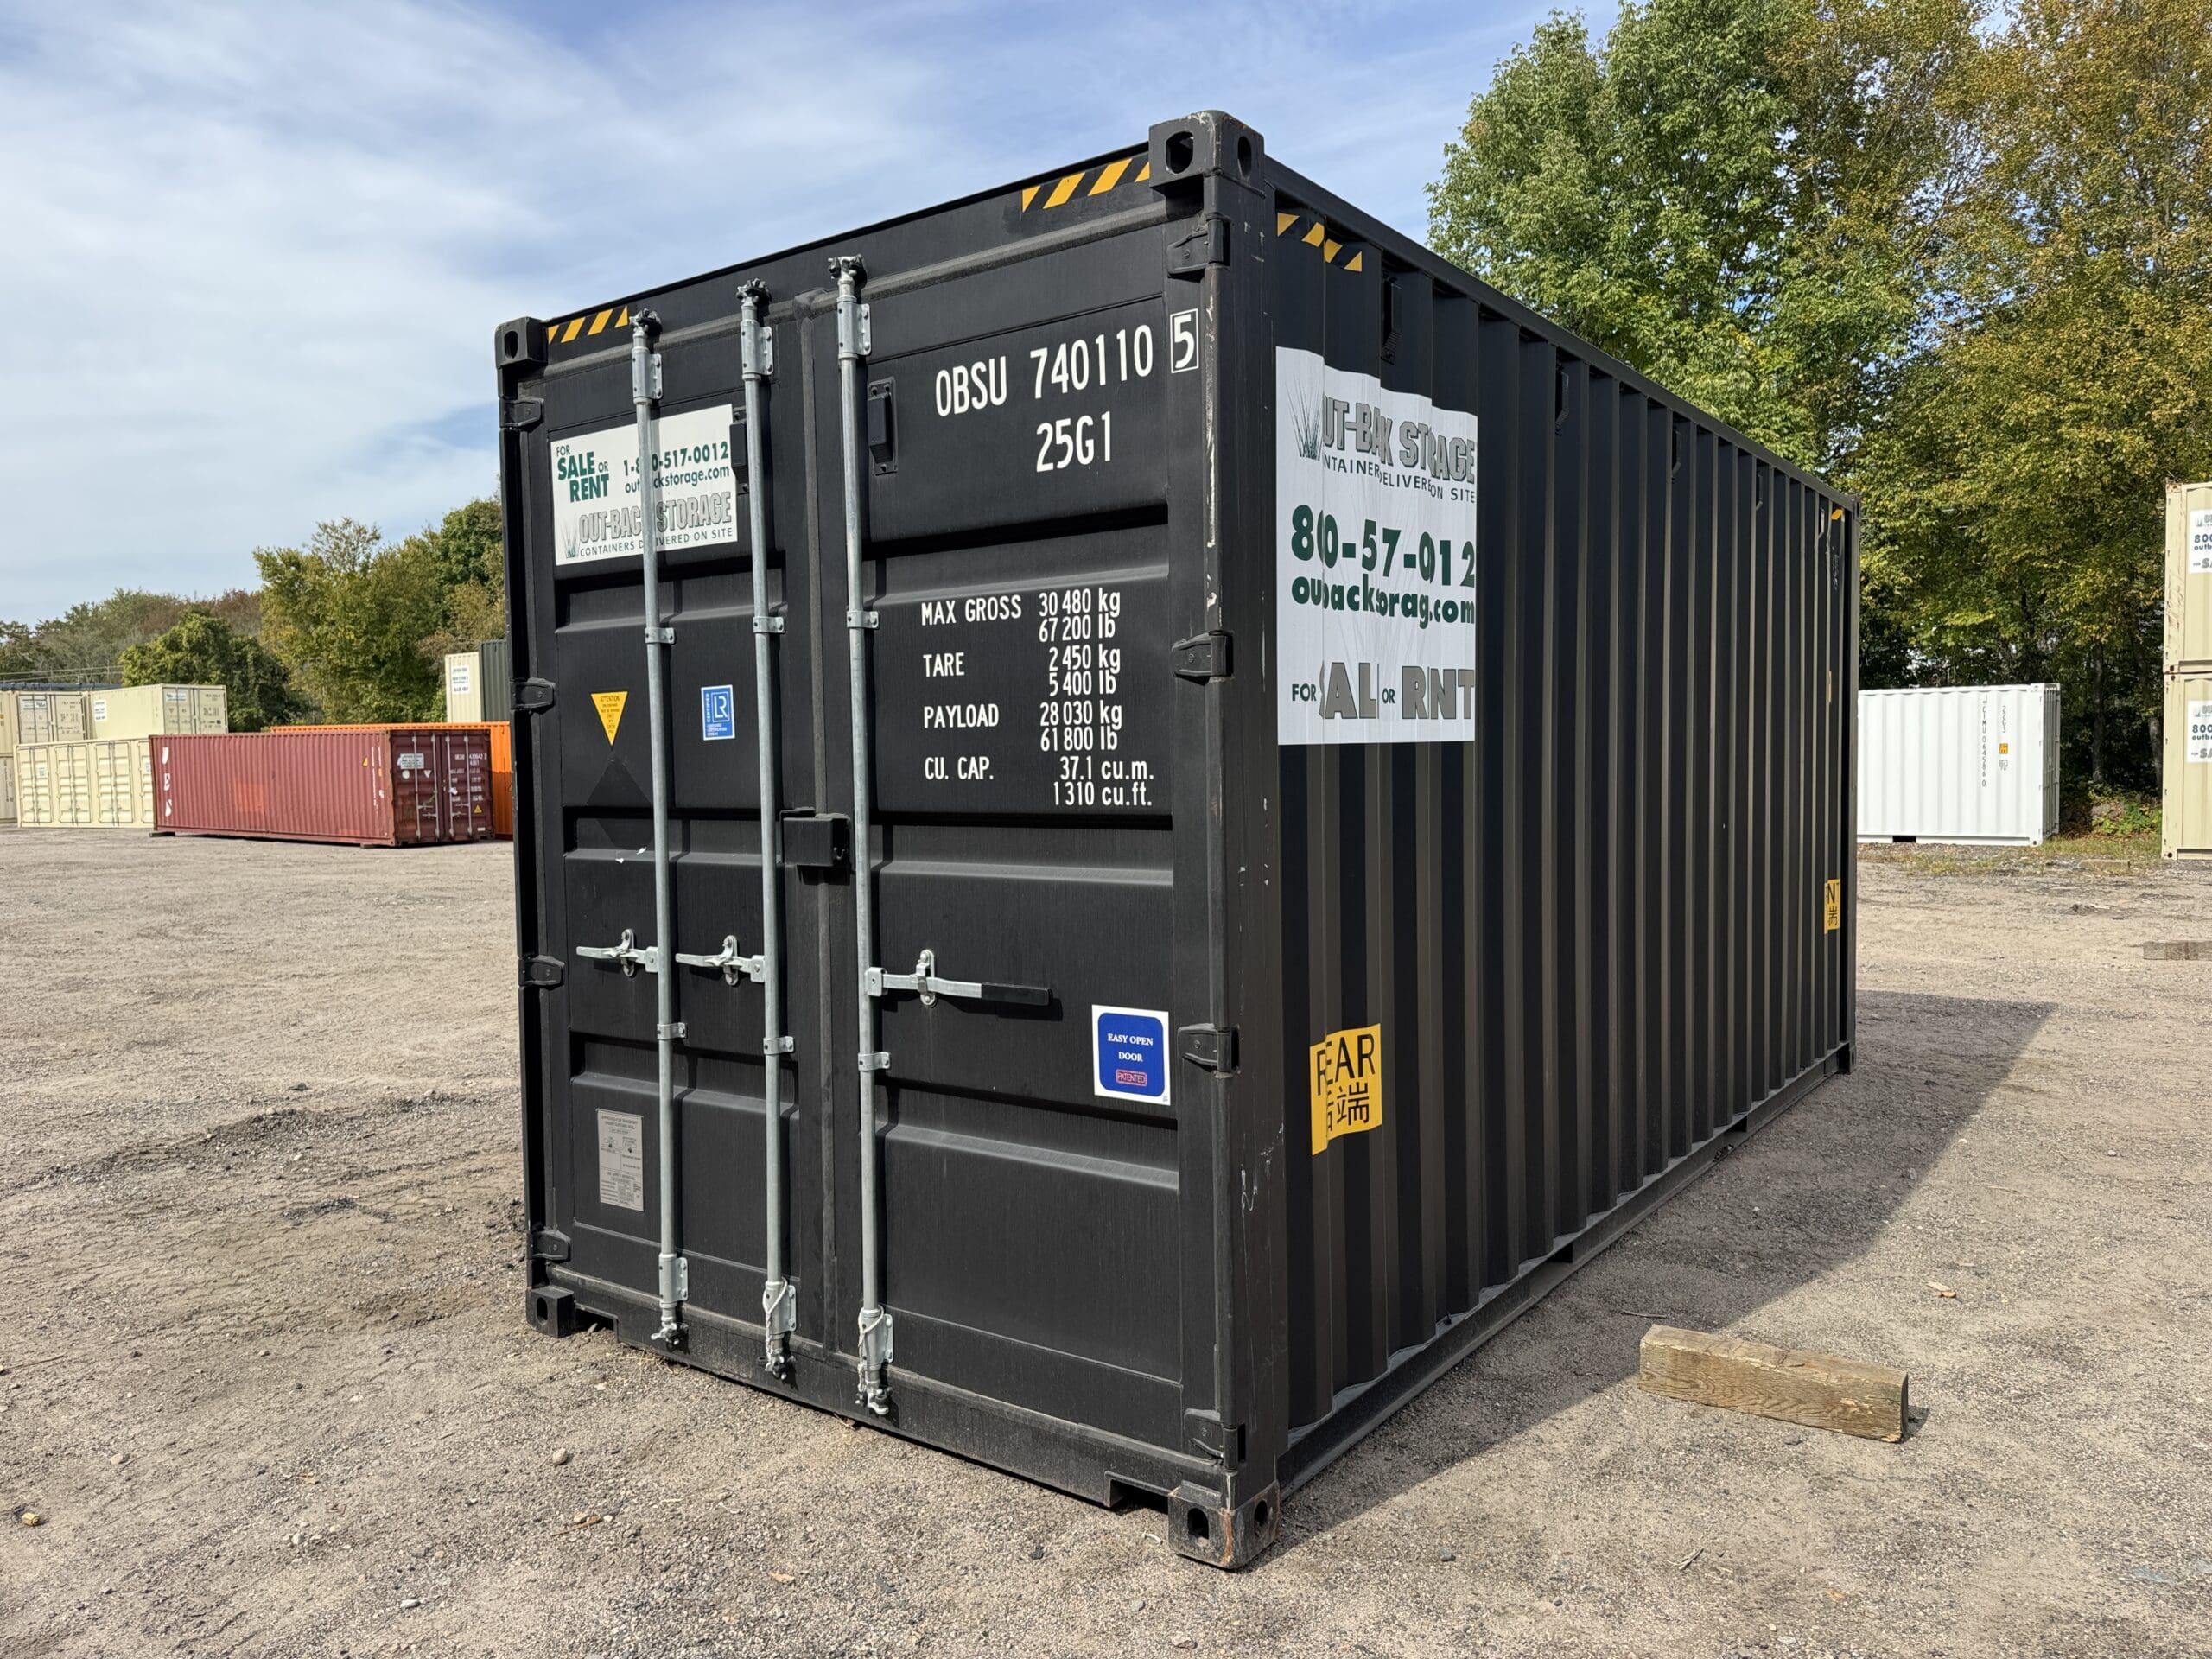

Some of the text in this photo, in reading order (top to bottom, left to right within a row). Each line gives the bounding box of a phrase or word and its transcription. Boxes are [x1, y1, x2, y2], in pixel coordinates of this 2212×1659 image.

[935, 314, 1195, 416] OBSU 740110 5
[556, 445, 570, 457] FOR
[1036, 410, 1111, 473] 25G1
[557, 451, 608, 480] SALE OR
[569, 474, 609, 503] RENT
[625, 467, 730, 494] outckstorage.com
[1430, 484, 1444, 499] ON
[1450, 487, 1476, 504] SITE
[579, 491, 733, 544] OUT-BAC STORAGE
[580, 541, 635, 557] CONTAINERS
[694, 531, 708, 543] ON
[711, 527, 733, 540] SITE
[921, 601, 957, 626] MAX
[964, 594, 1022, 622] GROSS
[1098, 588, 1121, 617] kg
[1098, 613, 1116, 639] lb
[923, 652, 965, 677] TARE
[1098, 644, 1121, 673] kg
[1099, 670, 1116, 694] lb
[1292, 683, 1317, 702] FOR
[1382, 688, 1396, 704] OR
[924, 704, 999, 728] PAYLOAD
[1099, 700, 1122, 730] kg
[1100, 726, 1118, 750] lb
[925, 756, 1154, 780] CU. CAP. 37.1 cu.m.
[1102, 781, 1153, 806] cu.ft.
[1107, 1033, 1154, 1046] EASY OPEN
[1118, 1051, 1143, 1062] DOOR
[1117, 1071, 1146, 1084] PATENTED
